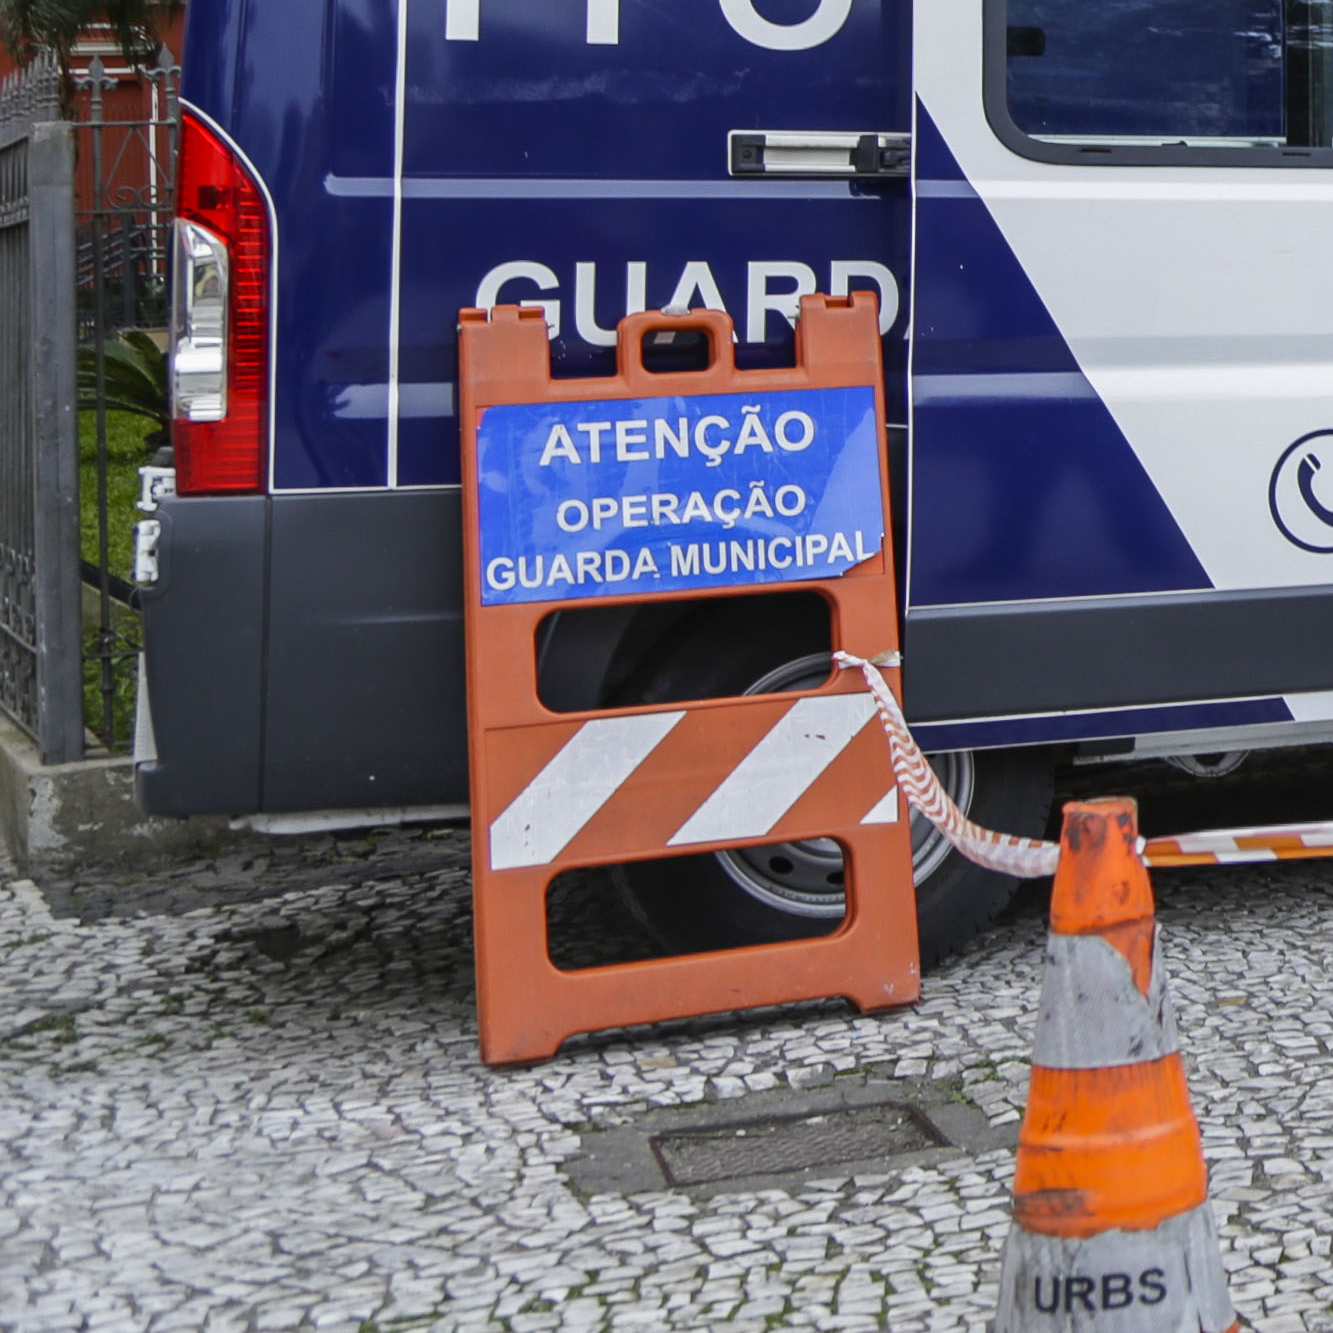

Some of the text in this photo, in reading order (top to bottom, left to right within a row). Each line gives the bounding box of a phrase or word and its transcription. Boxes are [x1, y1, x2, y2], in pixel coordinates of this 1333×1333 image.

[475, 260, 911, 348] GUARD
[538, 404, 815, 467] ATENÇÃO
[556, 480, 806, 532] OPERAÇÃO
[486, 530, 878, 591] GUARDA MUNICIPAL
[1034, 1268, 1168, 1314] URBS
